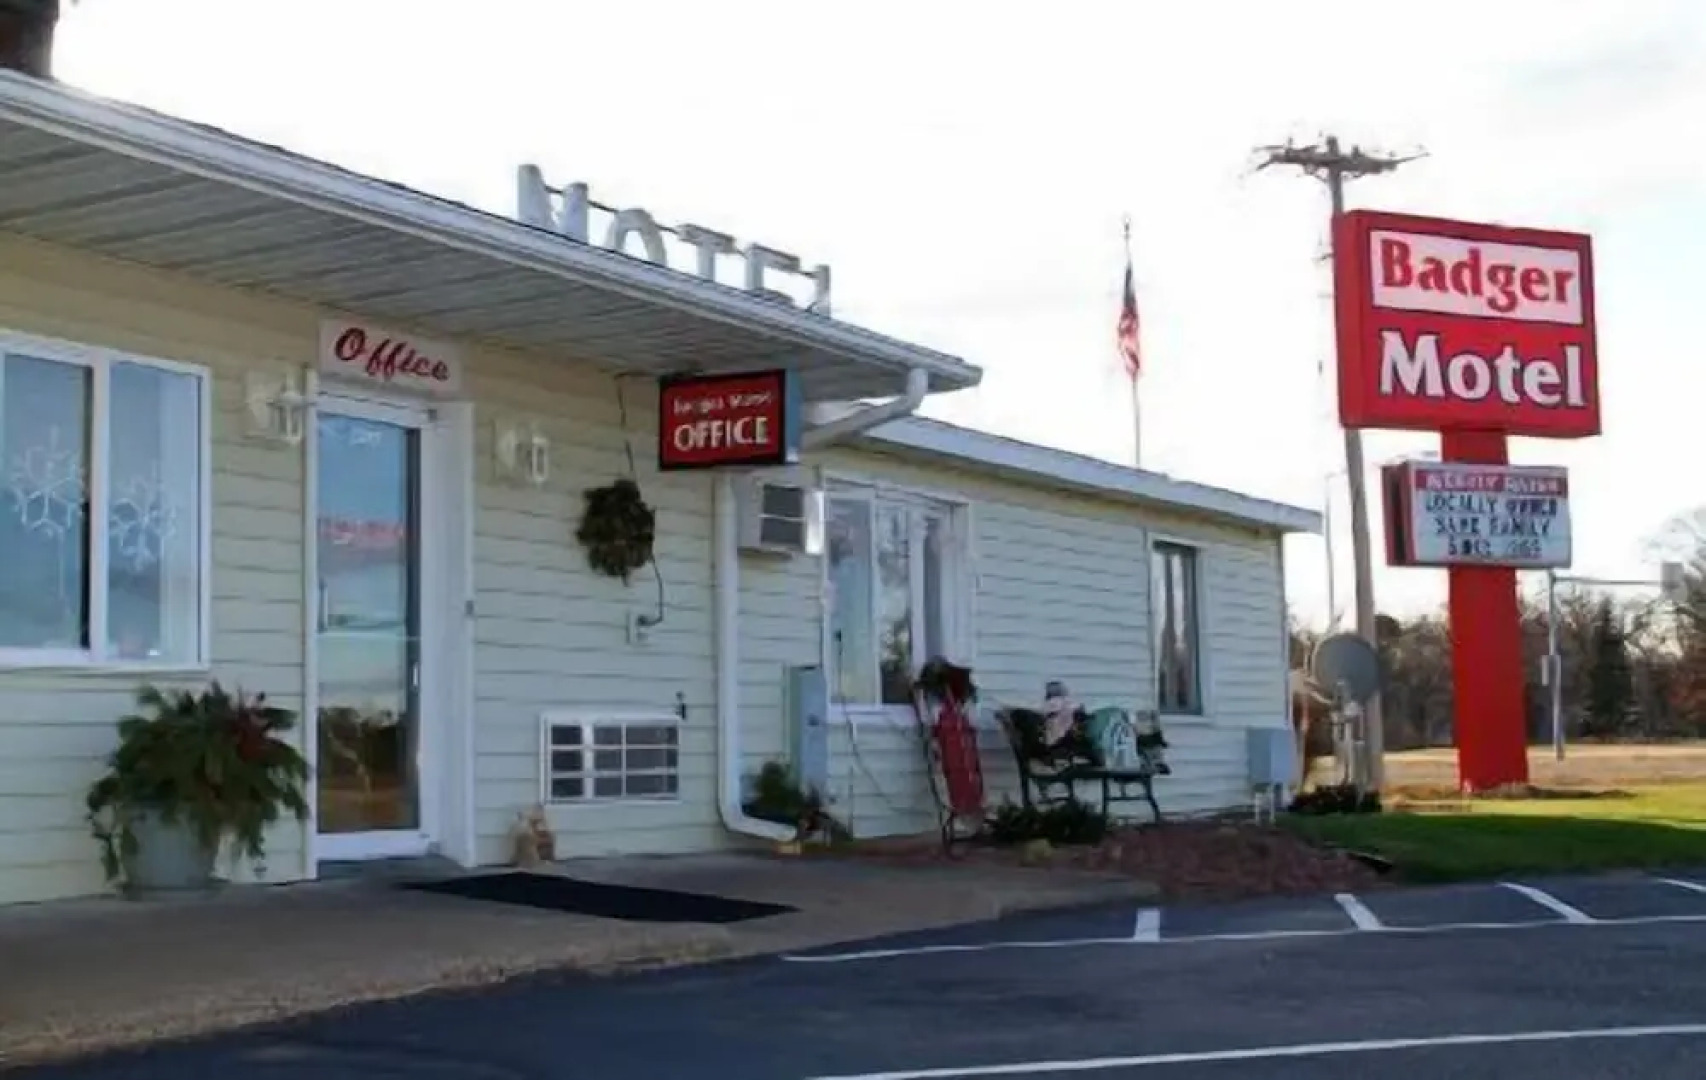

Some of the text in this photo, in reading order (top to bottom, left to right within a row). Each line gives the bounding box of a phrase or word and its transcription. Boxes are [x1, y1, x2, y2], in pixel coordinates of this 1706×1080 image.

[1380, 238, 1574, 313] Badger
[334, 327, 449, 382] Office
[1379, 329, 1586, 408] Motel
[673, 417, 769, 452] OFFICE
